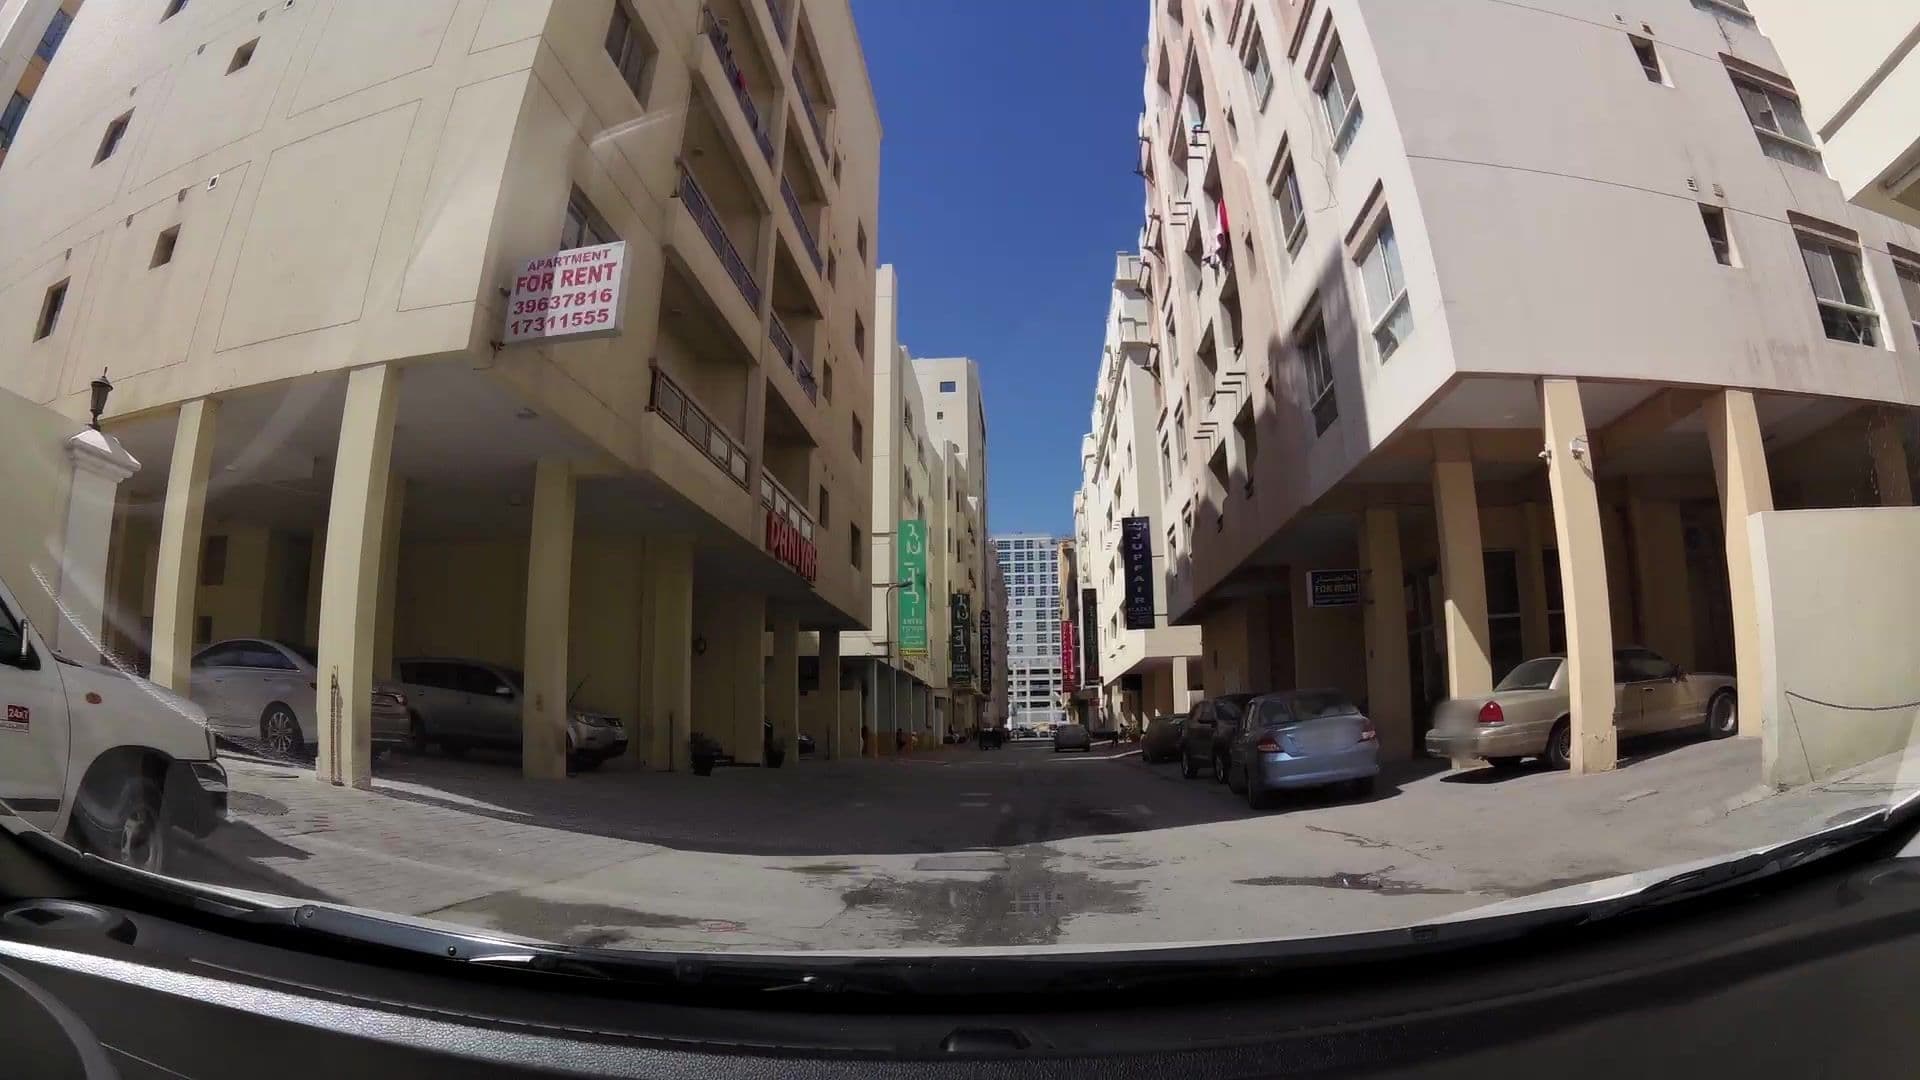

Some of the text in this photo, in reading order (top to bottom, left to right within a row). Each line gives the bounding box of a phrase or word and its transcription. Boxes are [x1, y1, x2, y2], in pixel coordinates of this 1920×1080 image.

[528, 249, 611, 271] APARTMENT
[516, 262, 617, 295] FOR RENT
[514, 288, 612, 315] 39637816
[511, 309, 609, 335] 17311555
